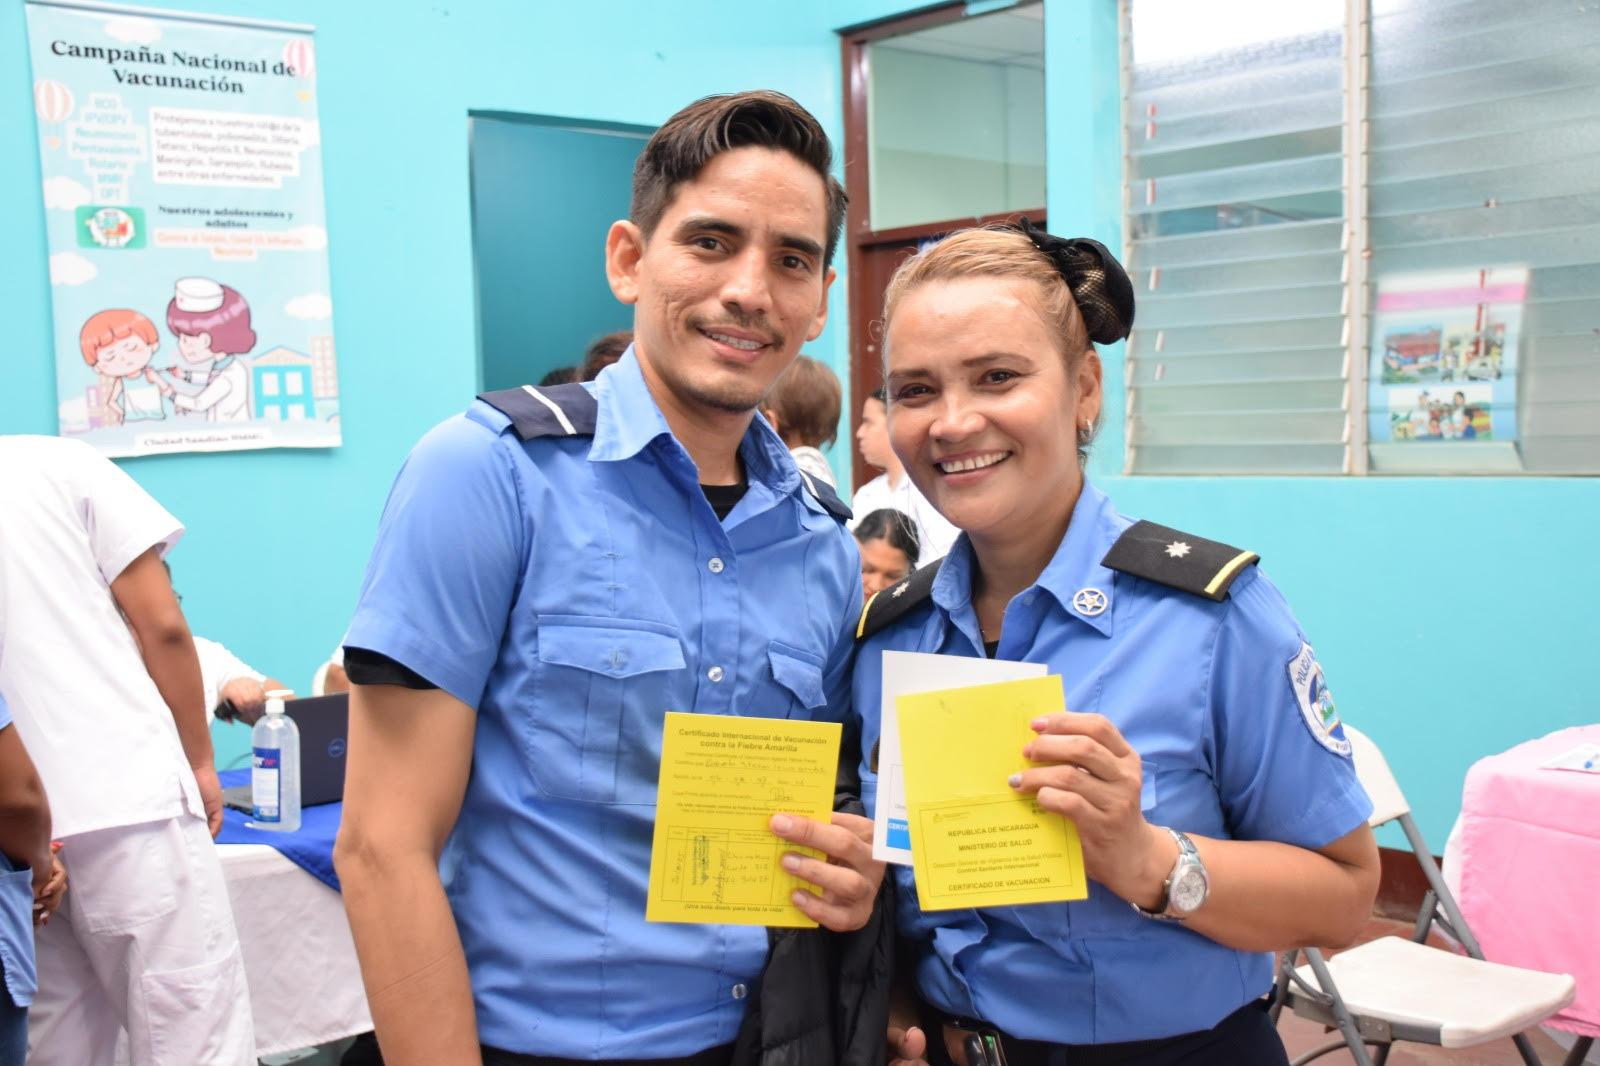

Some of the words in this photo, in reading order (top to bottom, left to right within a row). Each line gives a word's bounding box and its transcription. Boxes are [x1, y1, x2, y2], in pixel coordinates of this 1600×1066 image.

[50, 40, 166, 65] Campaña
[172, 51, 266, 74] Nacional
[272, 61, 296, 77] de
[113, 69, 244, 93] Vacunación
[679, 728, 720, 739] Certificado
[722, 731, 771, 742] Internacional
[784, 734, 828, 745] Vacunación
[700, 741, 726, 749] contra
[738, 742, 763, 751] Fiebre
[765, 744, 798, 752] Amarilla
[948, 827, 987, 837] REPUBLICA
[988, 826, 998, 834] DE
[999, 822, 1040, 833] NICARAGUA
[958, 842, 997, 852] MINISTERIO
[1010, 838, 1032, 847] SALUD
[948, 880, 994, 892] CERTIFICADO
[994, 880, 1004, 888] DE
[1006, 877, 1050, 887] VACUNACION
